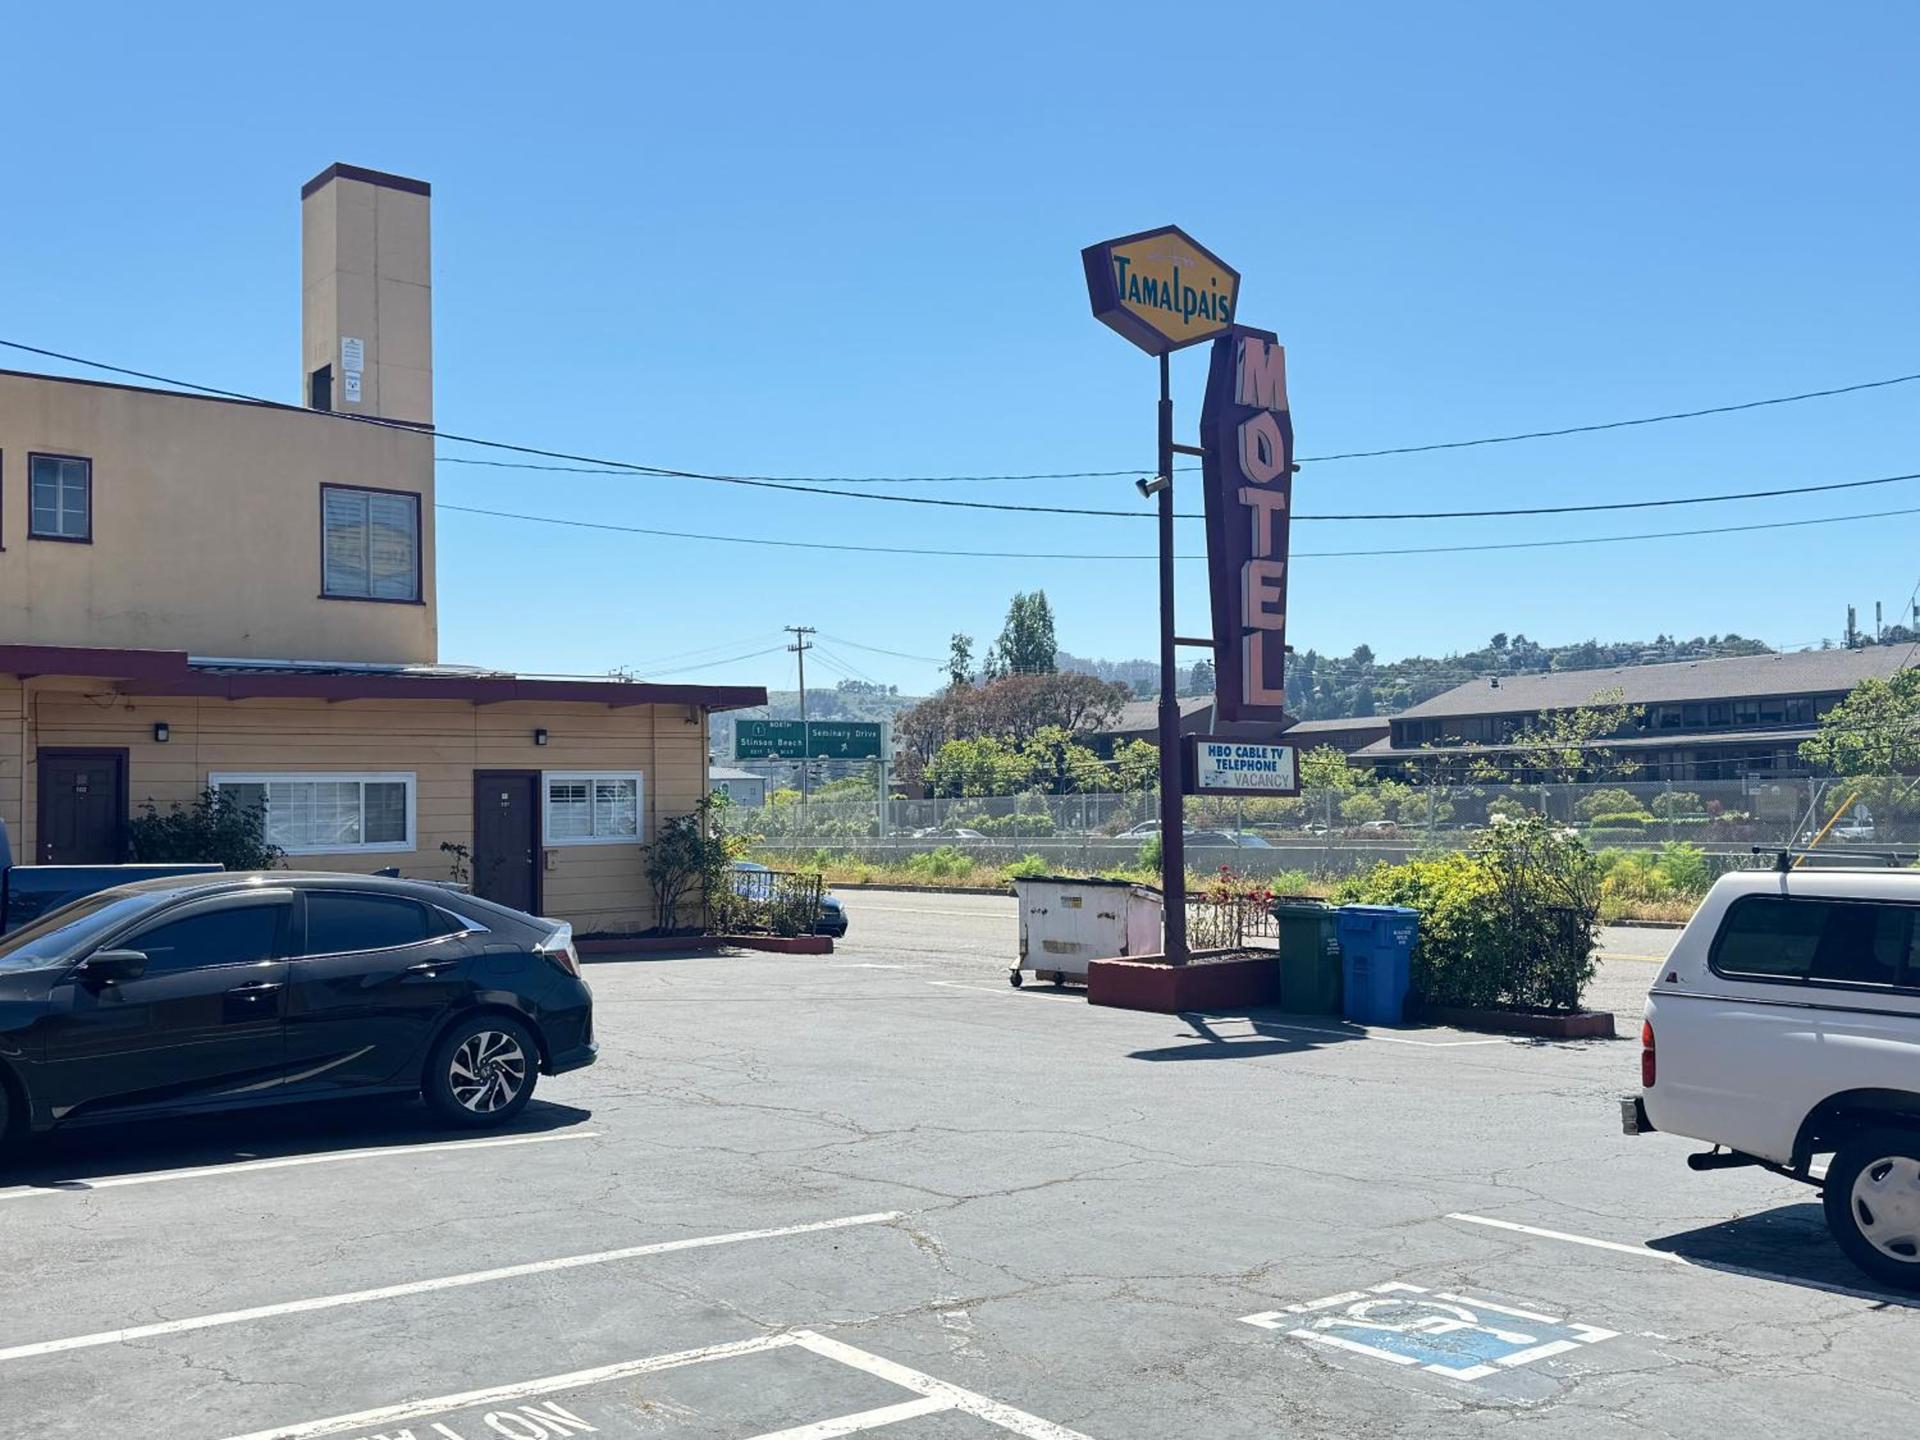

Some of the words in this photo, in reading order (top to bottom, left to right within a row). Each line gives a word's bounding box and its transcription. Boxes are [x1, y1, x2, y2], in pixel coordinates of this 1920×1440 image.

[1234, 337, 1289, 706] MOTEL
[812, 729, 850, 739] Seminary
[741, 738, 773, 746] Stinson
[778, 738, 803, 746] Beach
[1208, 744, 1232, 758] HBO
[1235, 746, 1267, 759] CABLE
[1270, 748, 1284, 760] TV
[1215, 758, 1278, 772] TELEPHONE
[1234, 773, 1290, 788] VACANCY
